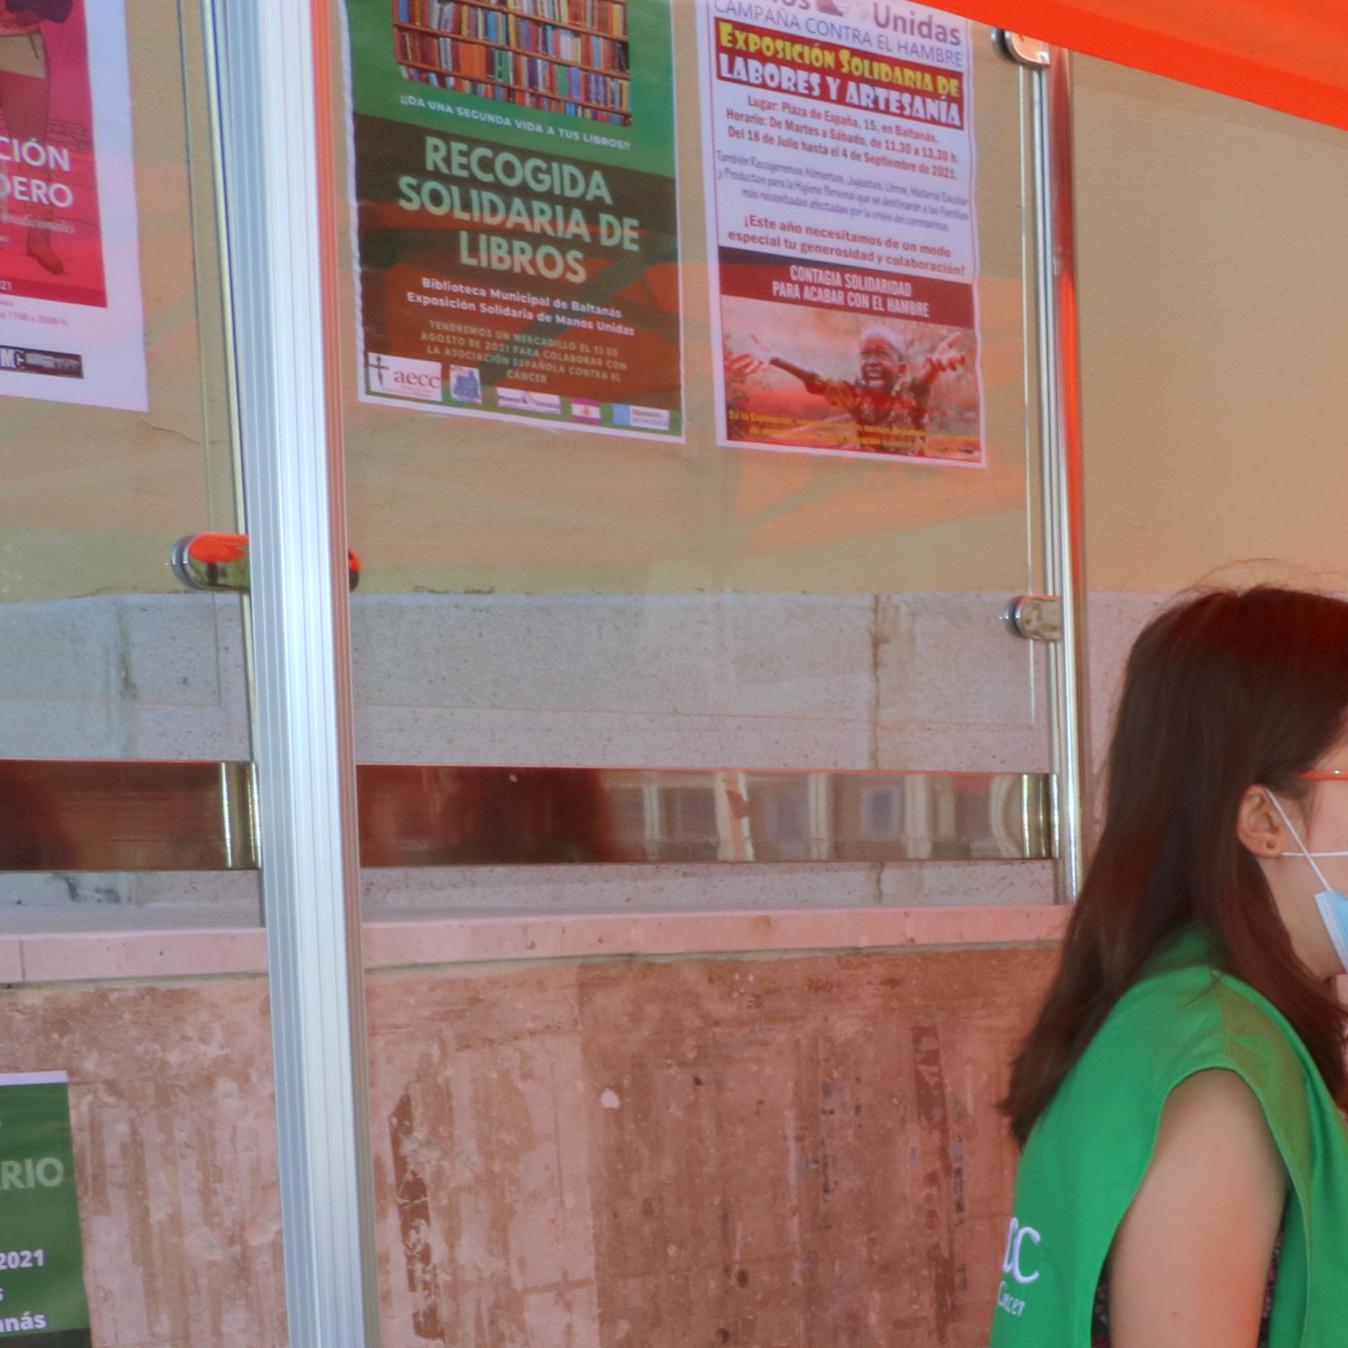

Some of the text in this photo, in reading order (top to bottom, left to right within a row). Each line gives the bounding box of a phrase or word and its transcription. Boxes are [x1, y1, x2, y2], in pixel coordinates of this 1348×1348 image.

[714, 0, 962, 67] CAMPAÑA CONTRA EL HAMBRE
[872, 1, 961, 46] Unidas
[719, 22, 960, 97] EXPOSICIÓN SOLIDARIA DE
[719, 53, 961, 126] LABORES Y ARTESANÍA
[428, 100, 454, 115] UNA
[456, 106, 512, 128] SEGUNDA
[515, 119, 544, 134] VIDA
[546, 124, 555, 136] A
[558, 127, 580, 142] TUS
[582, 132, 631, 150] LIBROS!!
[425, 136, 614, 206] RECOGIDA
[399, 175, 640, 252] SOLIDARIA DE
[460, 230, 588, 284] LIBROS
[744, 215, 951, 258] ¡Este año necesitamos de un modo
[422, 277, 622, 319] Biblioteca Municipal de Baltanás
[772, 280, 930, 317] PARA ACABAR CON EL HAMBRE
[790, 264, 912, 297] CONTAGIA SOLIDARIDAD
[407, 292, 635, 336] Exposición Solidaria de Manos Unidas
[394, 366, 441, 389] aecc
[0, 1156, 64, 1191] RIO
